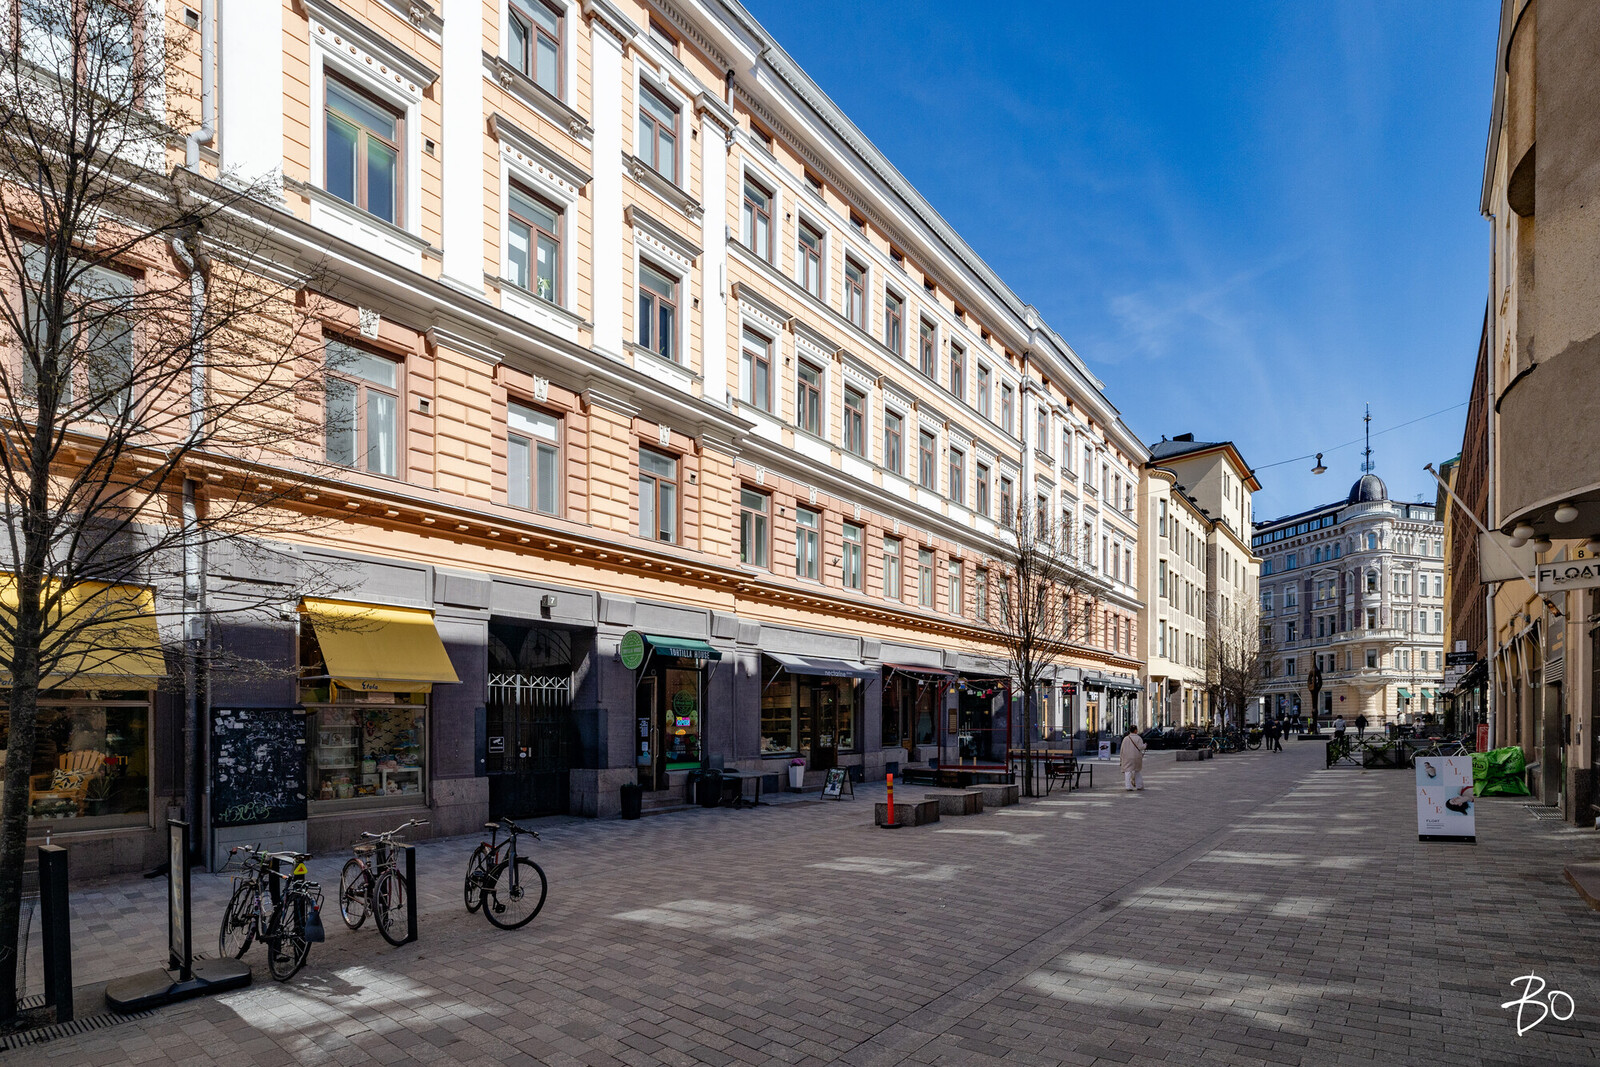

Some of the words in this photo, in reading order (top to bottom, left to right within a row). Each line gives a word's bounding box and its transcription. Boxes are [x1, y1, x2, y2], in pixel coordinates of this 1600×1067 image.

[1578, 550, 1584, 558] 8
[1540, 564, 1600, 582] FLOAT
[669, 648, 692, 658] TORTILLA
